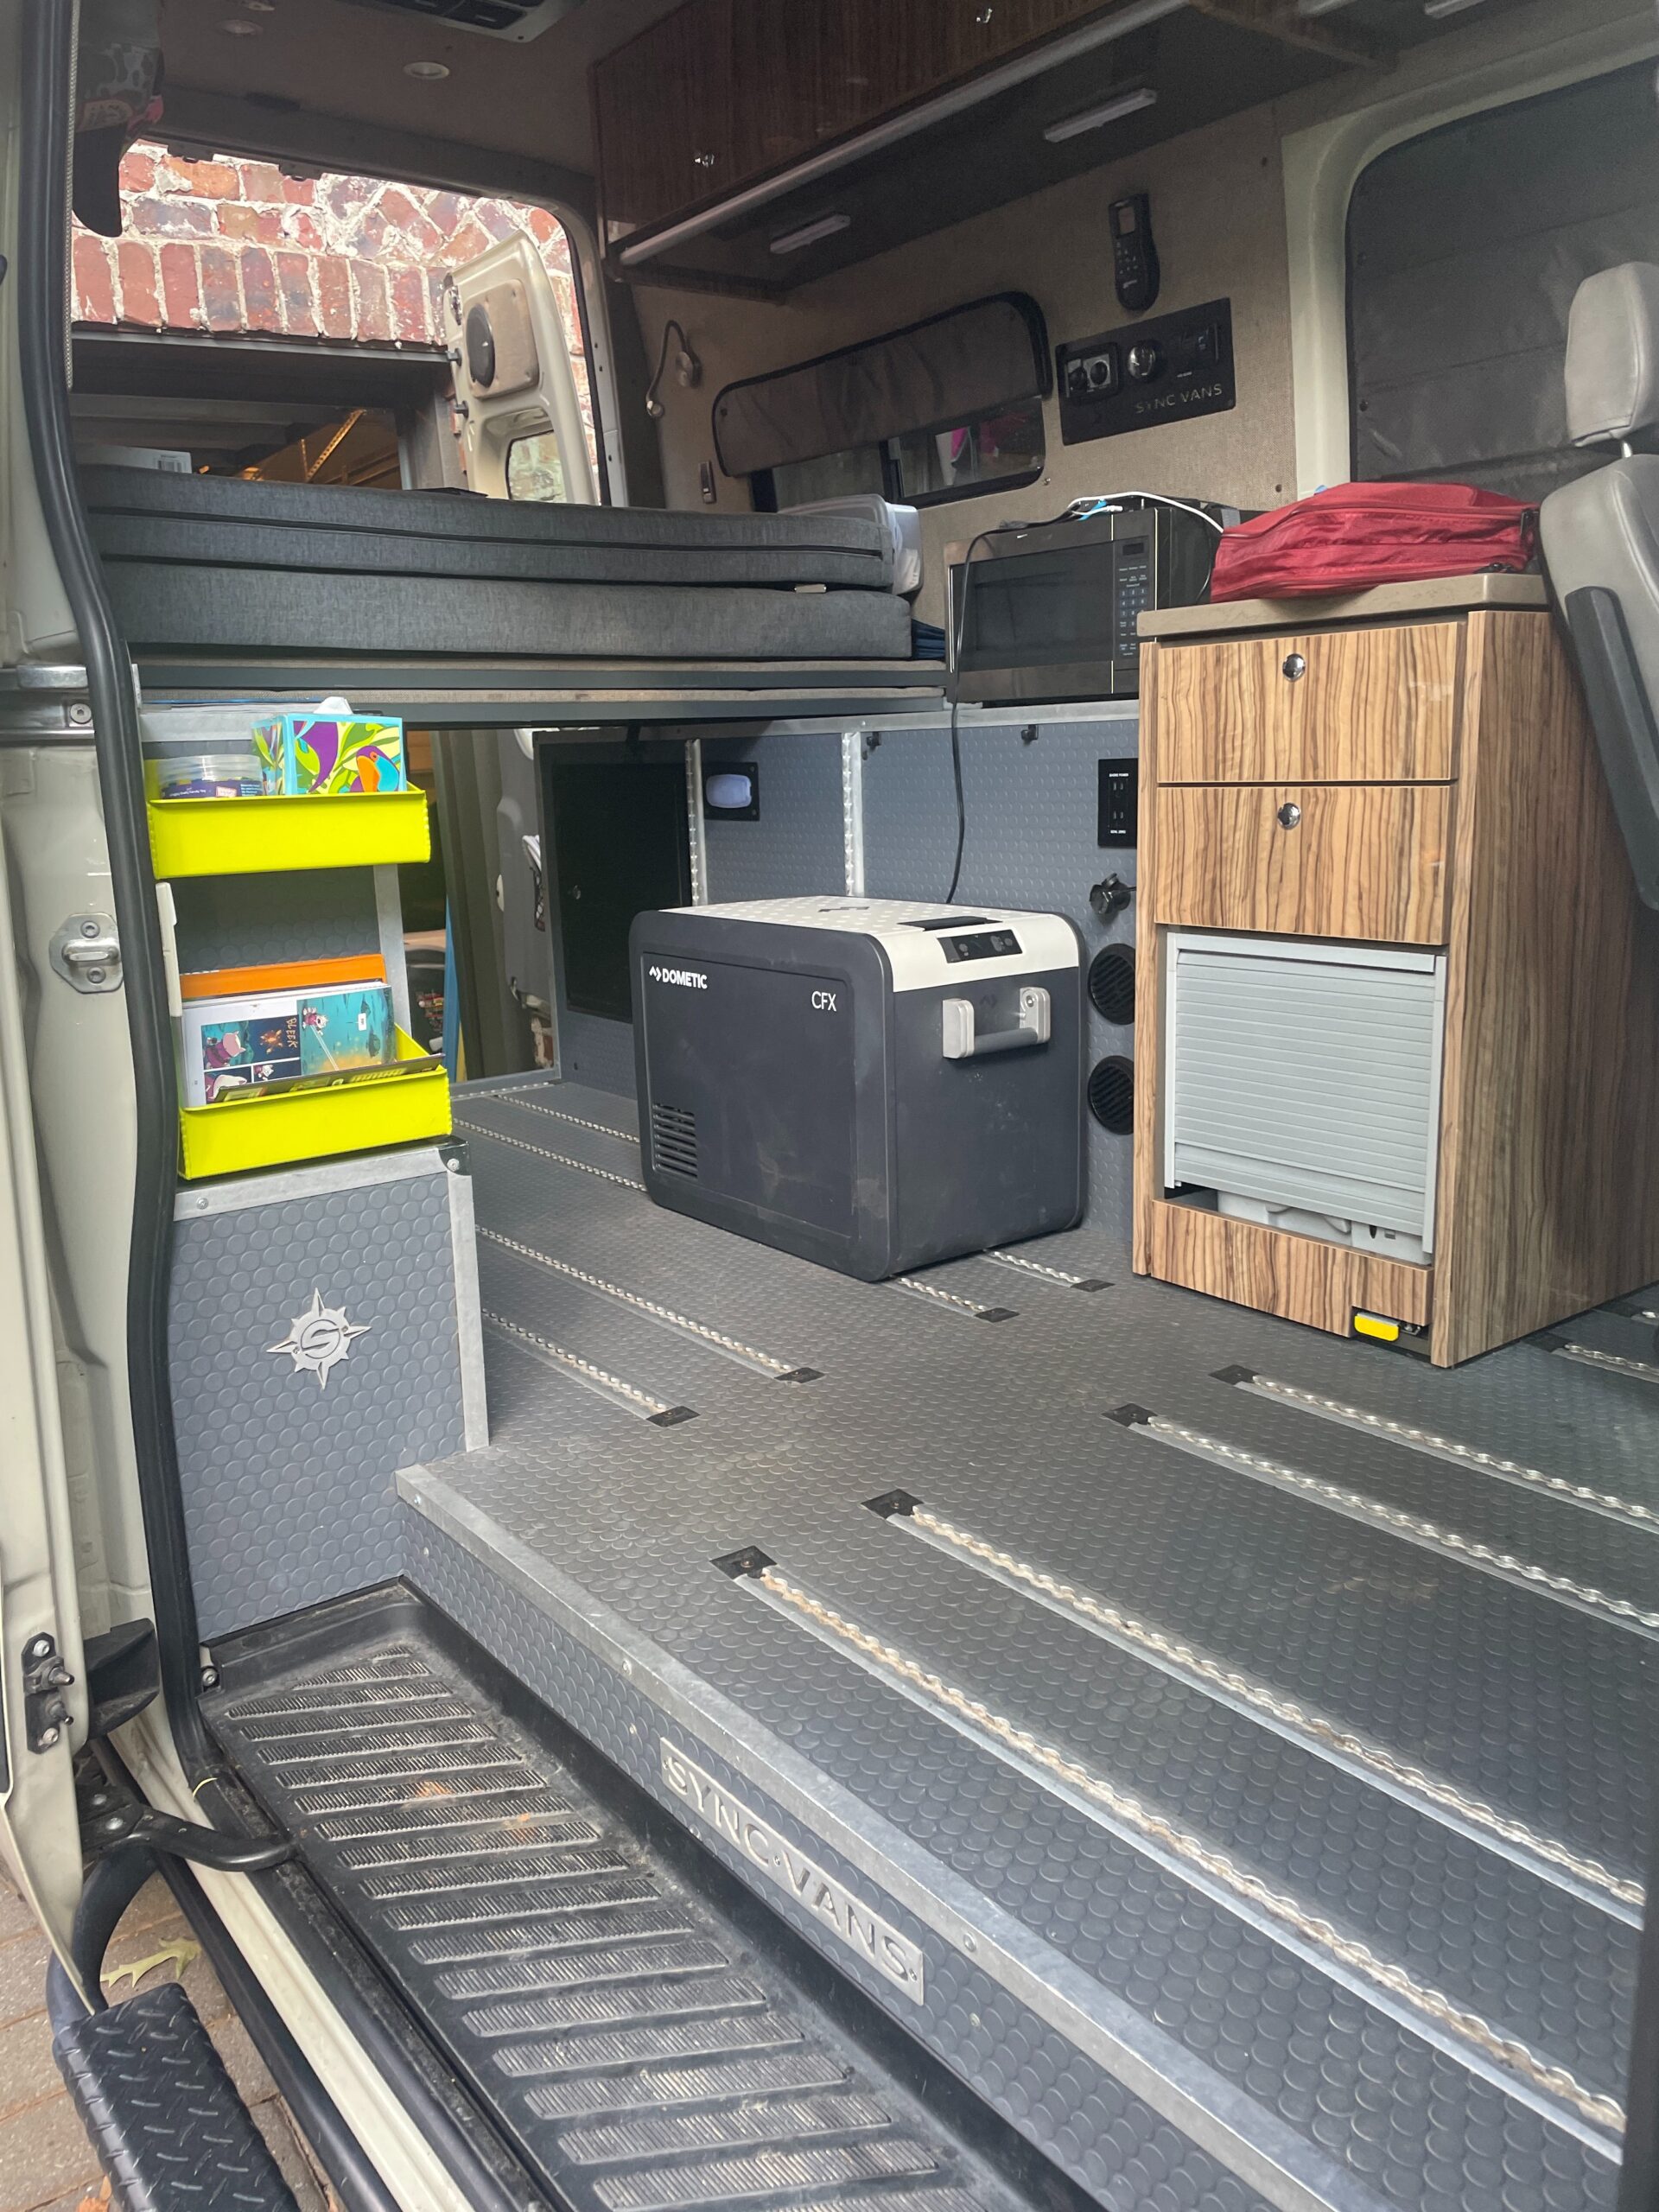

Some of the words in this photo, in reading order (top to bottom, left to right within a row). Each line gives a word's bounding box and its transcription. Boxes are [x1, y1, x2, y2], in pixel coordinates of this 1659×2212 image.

[1135, 393, 1176, 414] SYNC
[1180, 383, 1223, 403] VANS
[662, 967, 708, 989] DOMETIC
[811, 990, 837, 1012] CFX
[667, 1755, 770, 1867] SYNC
[780, 1847, 912, 1985] VANS
